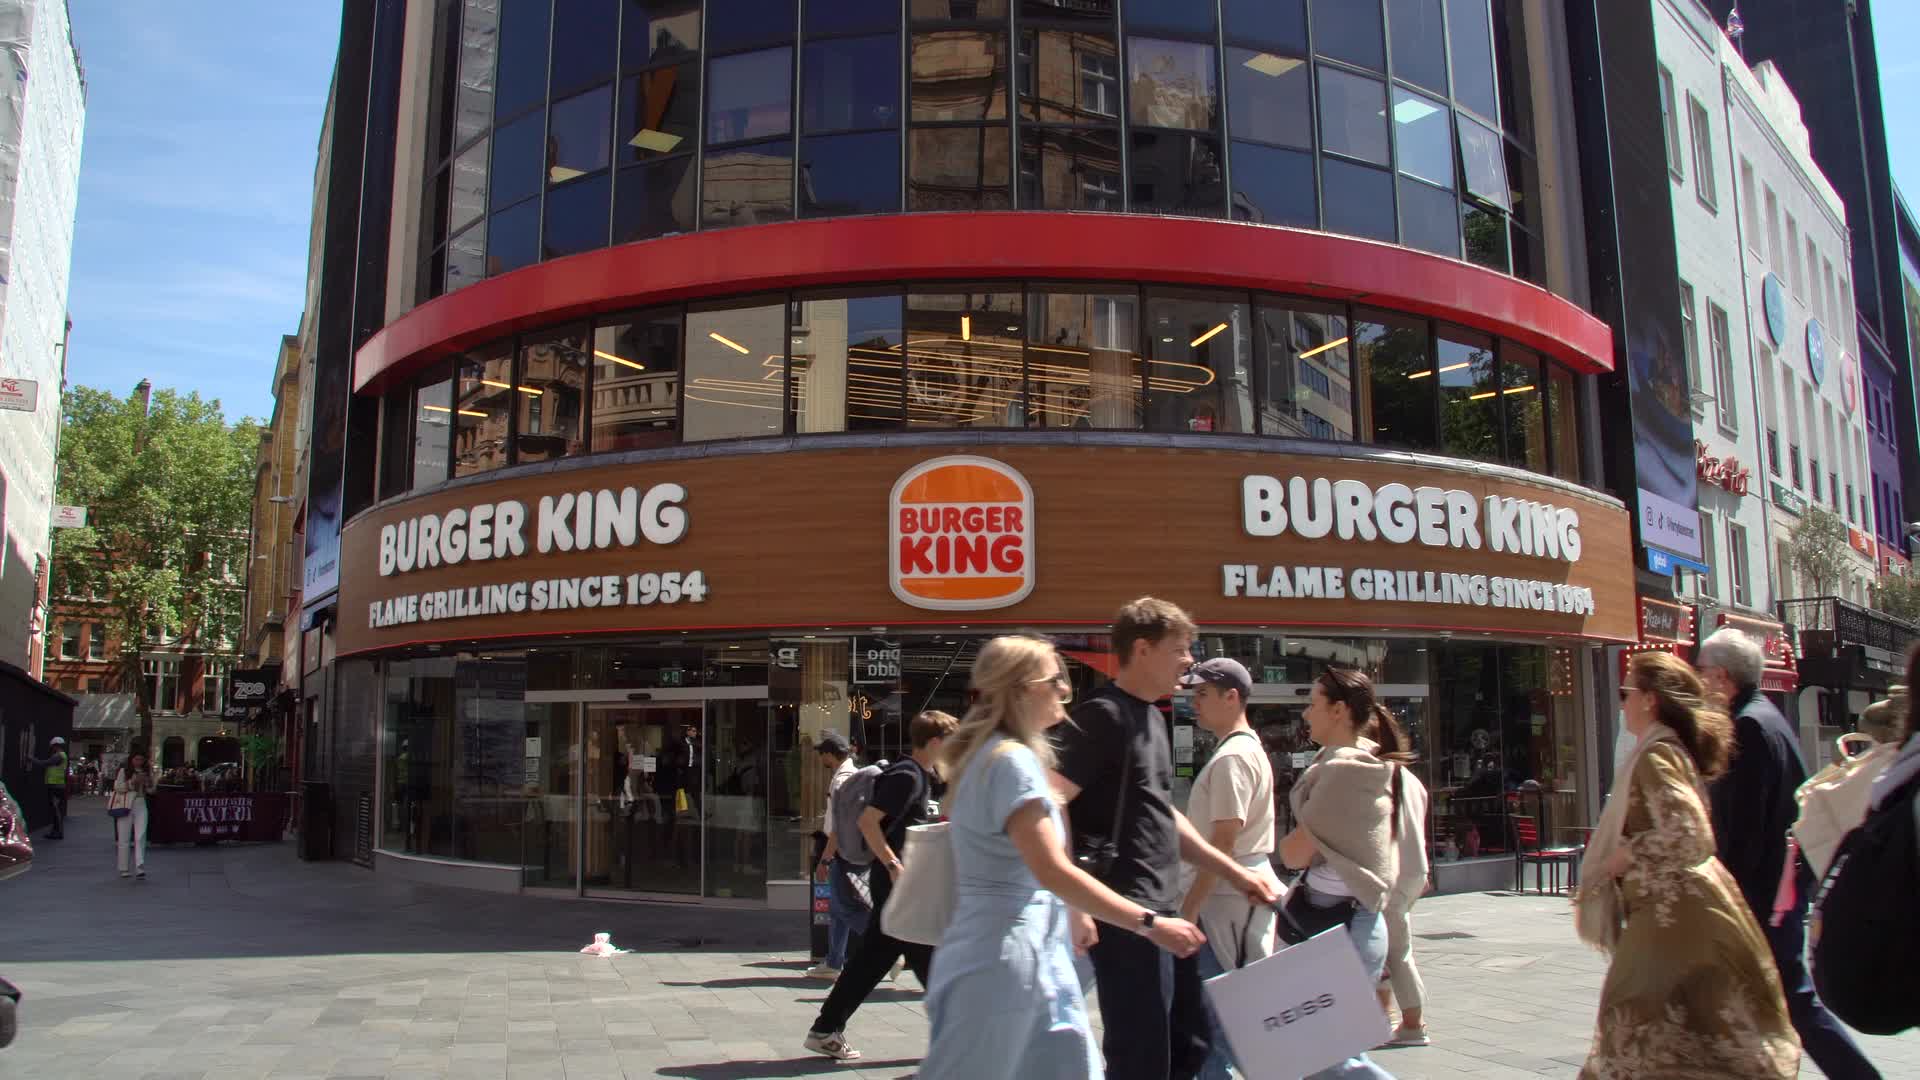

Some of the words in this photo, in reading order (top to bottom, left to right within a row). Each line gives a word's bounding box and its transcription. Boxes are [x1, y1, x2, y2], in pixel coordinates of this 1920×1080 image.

[379, 500, 527, 576] BURGER
[537, 482, 689, 554] KING
[900, 506, 1024, 534] BURGER
[1242, 474, 1481, 551] BURGER
[1484, 494, 1582, 562] KING
[900, 534, 1024, 574] KING
[368, 593, 418, 629] FLAME
[420, 581, 529, 622] GRILLING
[531, 575, 623, 611] SINCE
[626, 569, 708, 605] 1954
[1222, 564, 1345, 599] FLAME
[1350, 568, 1488, 606] GRILLING
[1490, 576, 1554, 612] SINCE
[1553, 583, 1595, 616] 1954
[1263, 992, 1335, 1032] REISS
